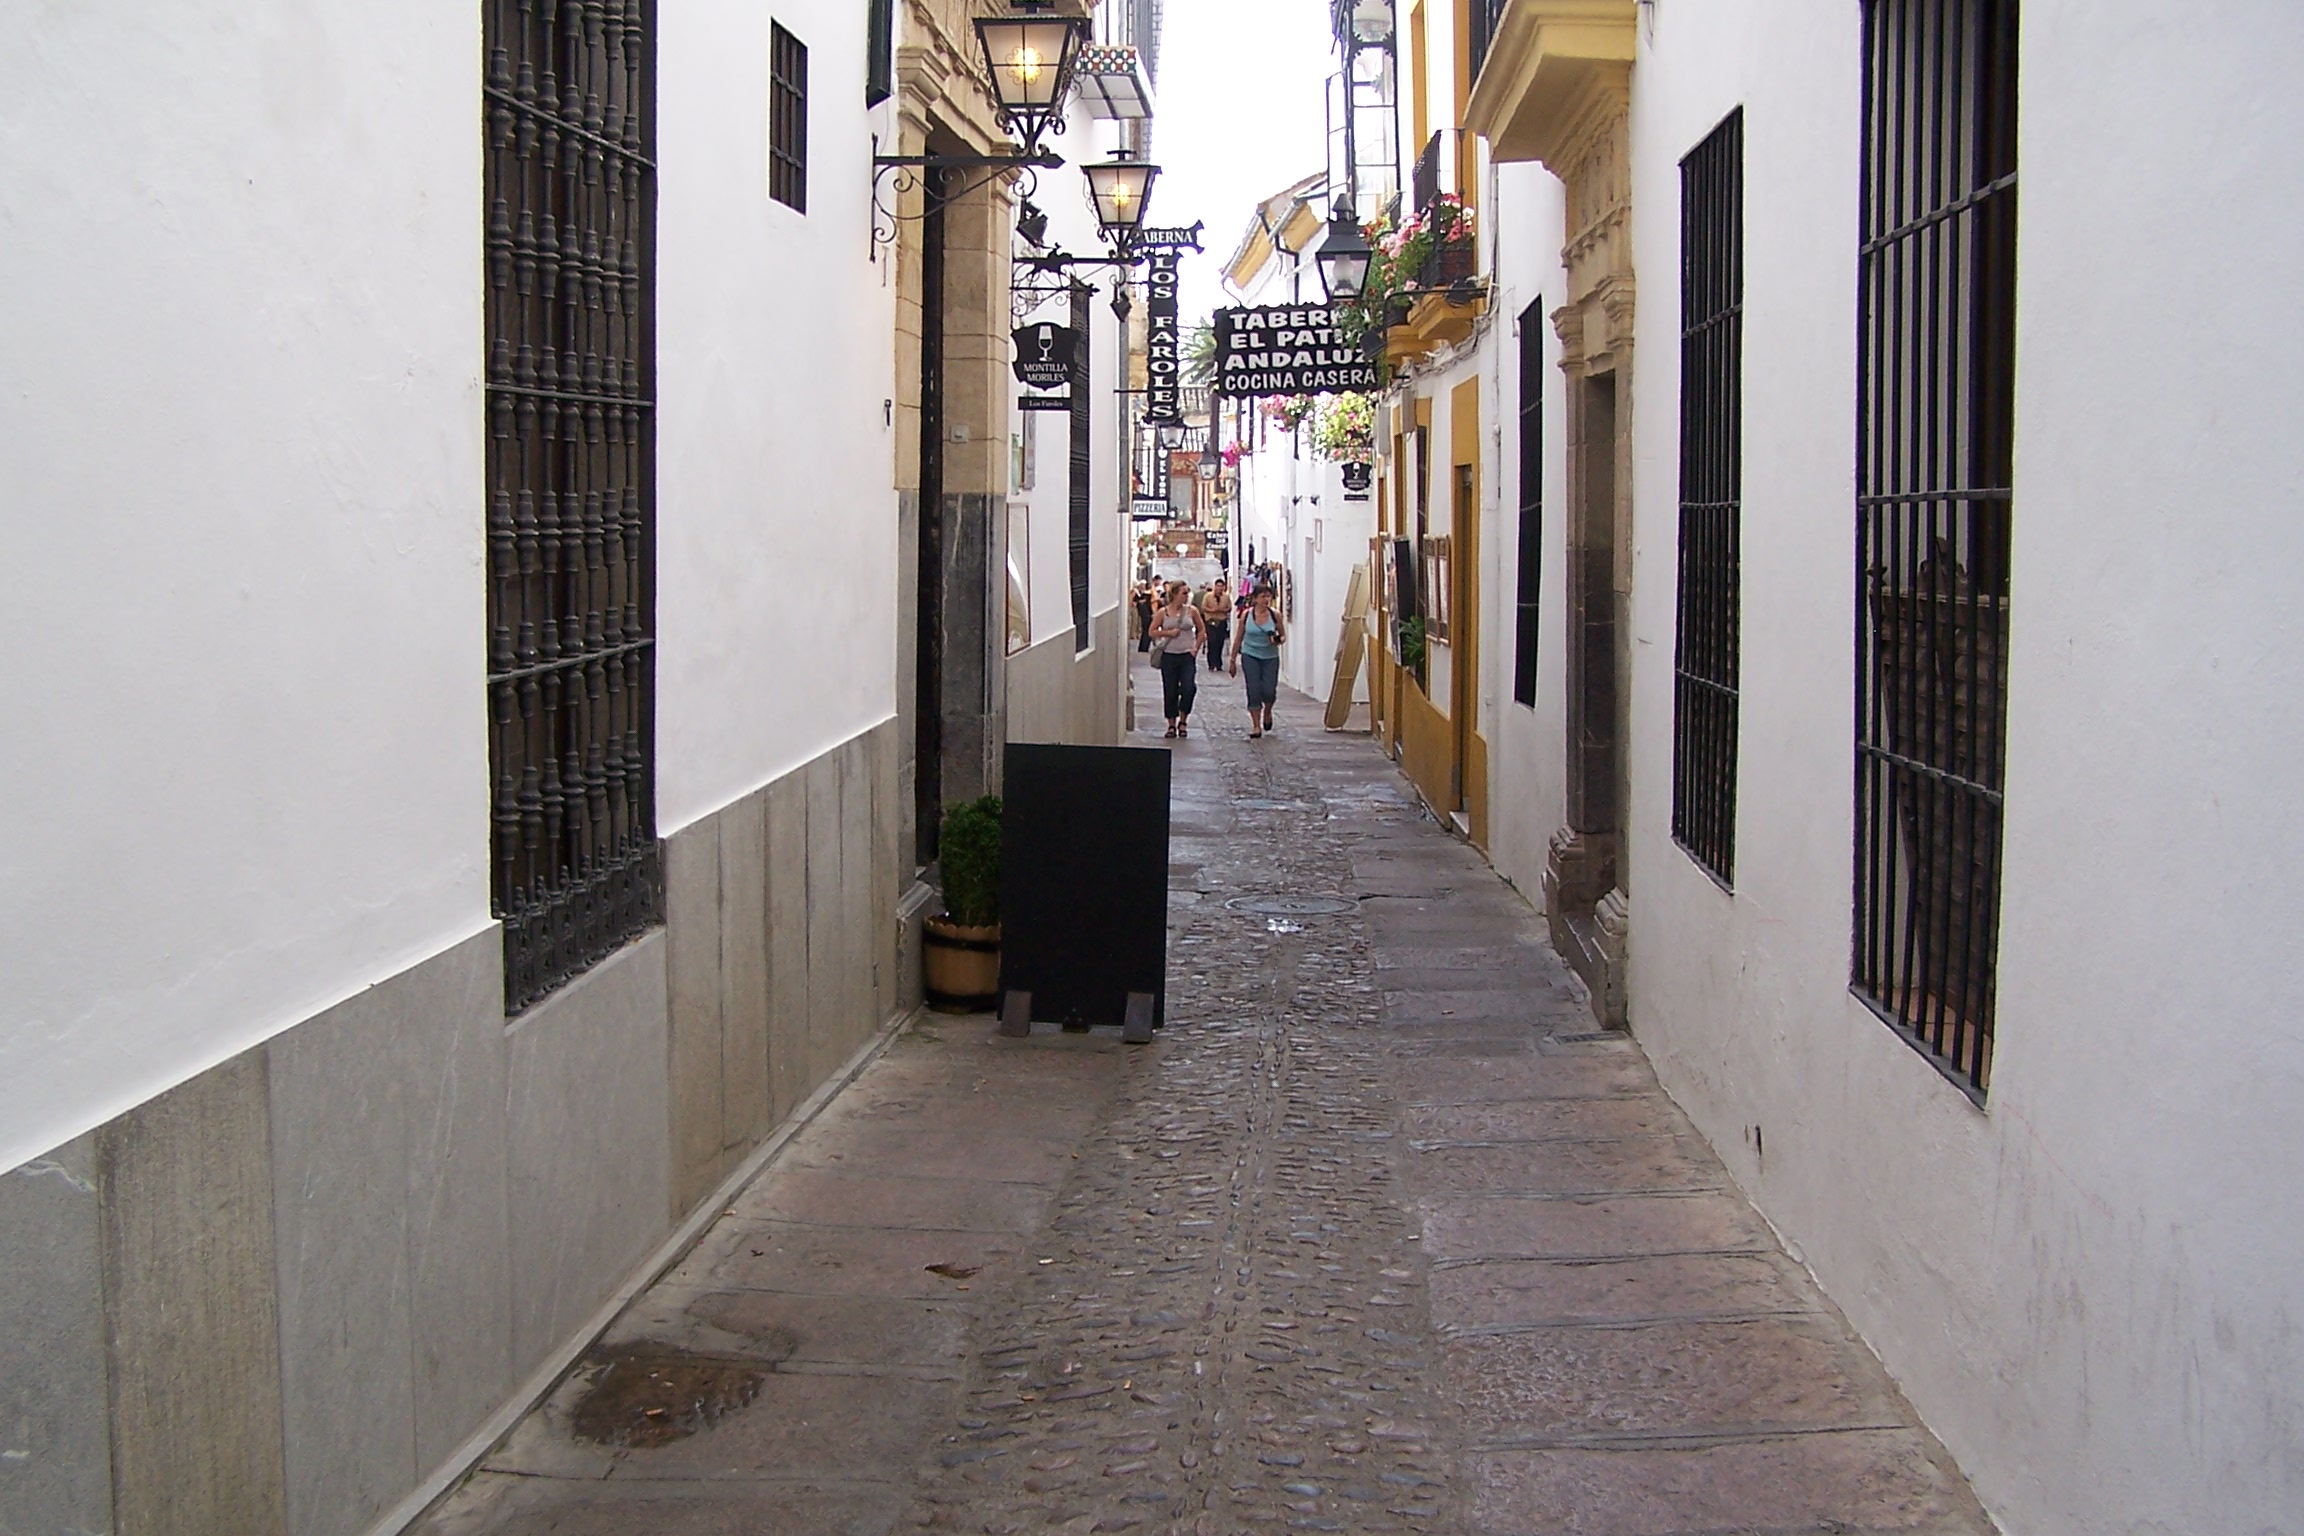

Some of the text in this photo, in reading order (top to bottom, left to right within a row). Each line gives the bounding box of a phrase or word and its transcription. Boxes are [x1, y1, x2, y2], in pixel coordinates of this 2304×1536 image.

[1142, 230, 1193, 244] ABERNA
[1150, 257, 1175, 417] LOS FAROLES
[1230, 328, 1362, 350] EL PATI
[1023, 363, 1068, 373] MONTILLA
[1224, 347, 1374, 371] ANDALUZ
[1027, 373, 1065, 382] MORILES
[1225, 368, 1376, 391] COCINA CASERA
[1134, 503, 1166, 513] PIZZERIA
